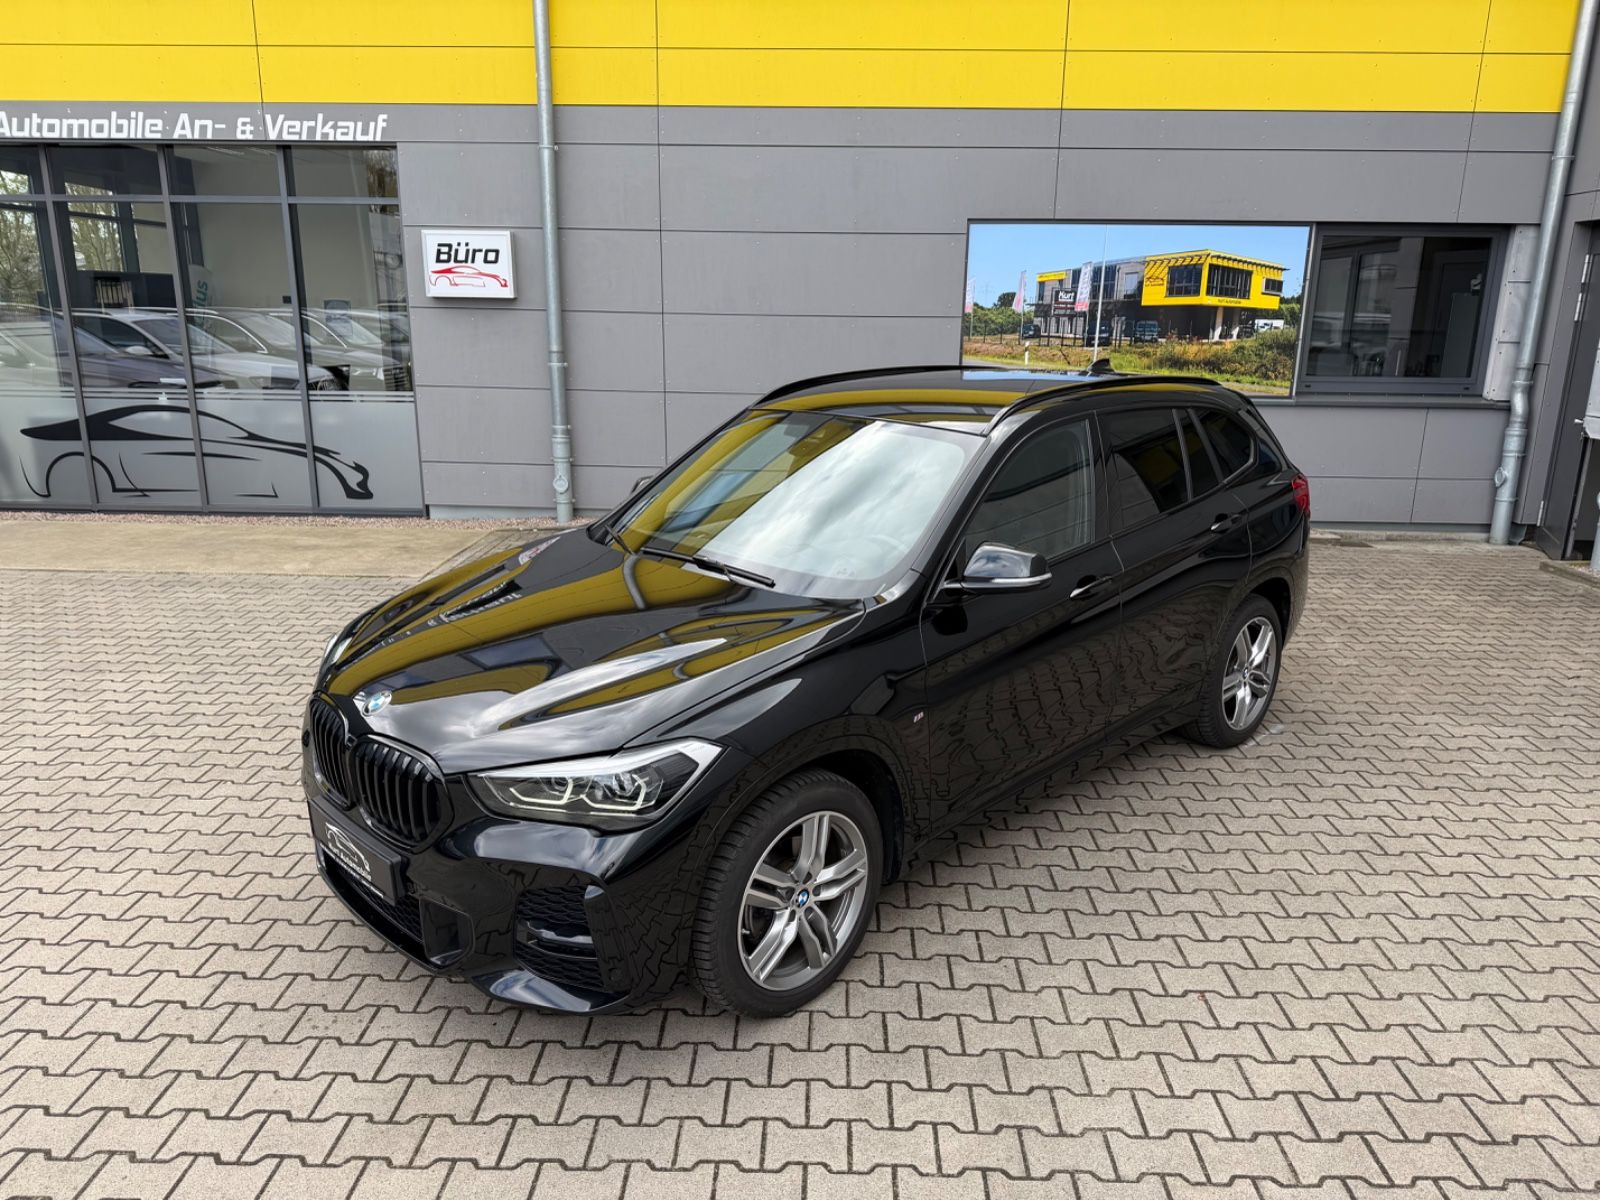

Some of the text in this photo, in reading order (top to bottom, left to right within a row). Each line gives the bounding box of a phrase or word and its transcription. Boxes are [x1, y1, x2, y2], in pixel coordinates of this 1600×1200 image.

[0, 110, 389, 141] Automobile An- & Verkauf
[435, 241, 501, 265] Büro
